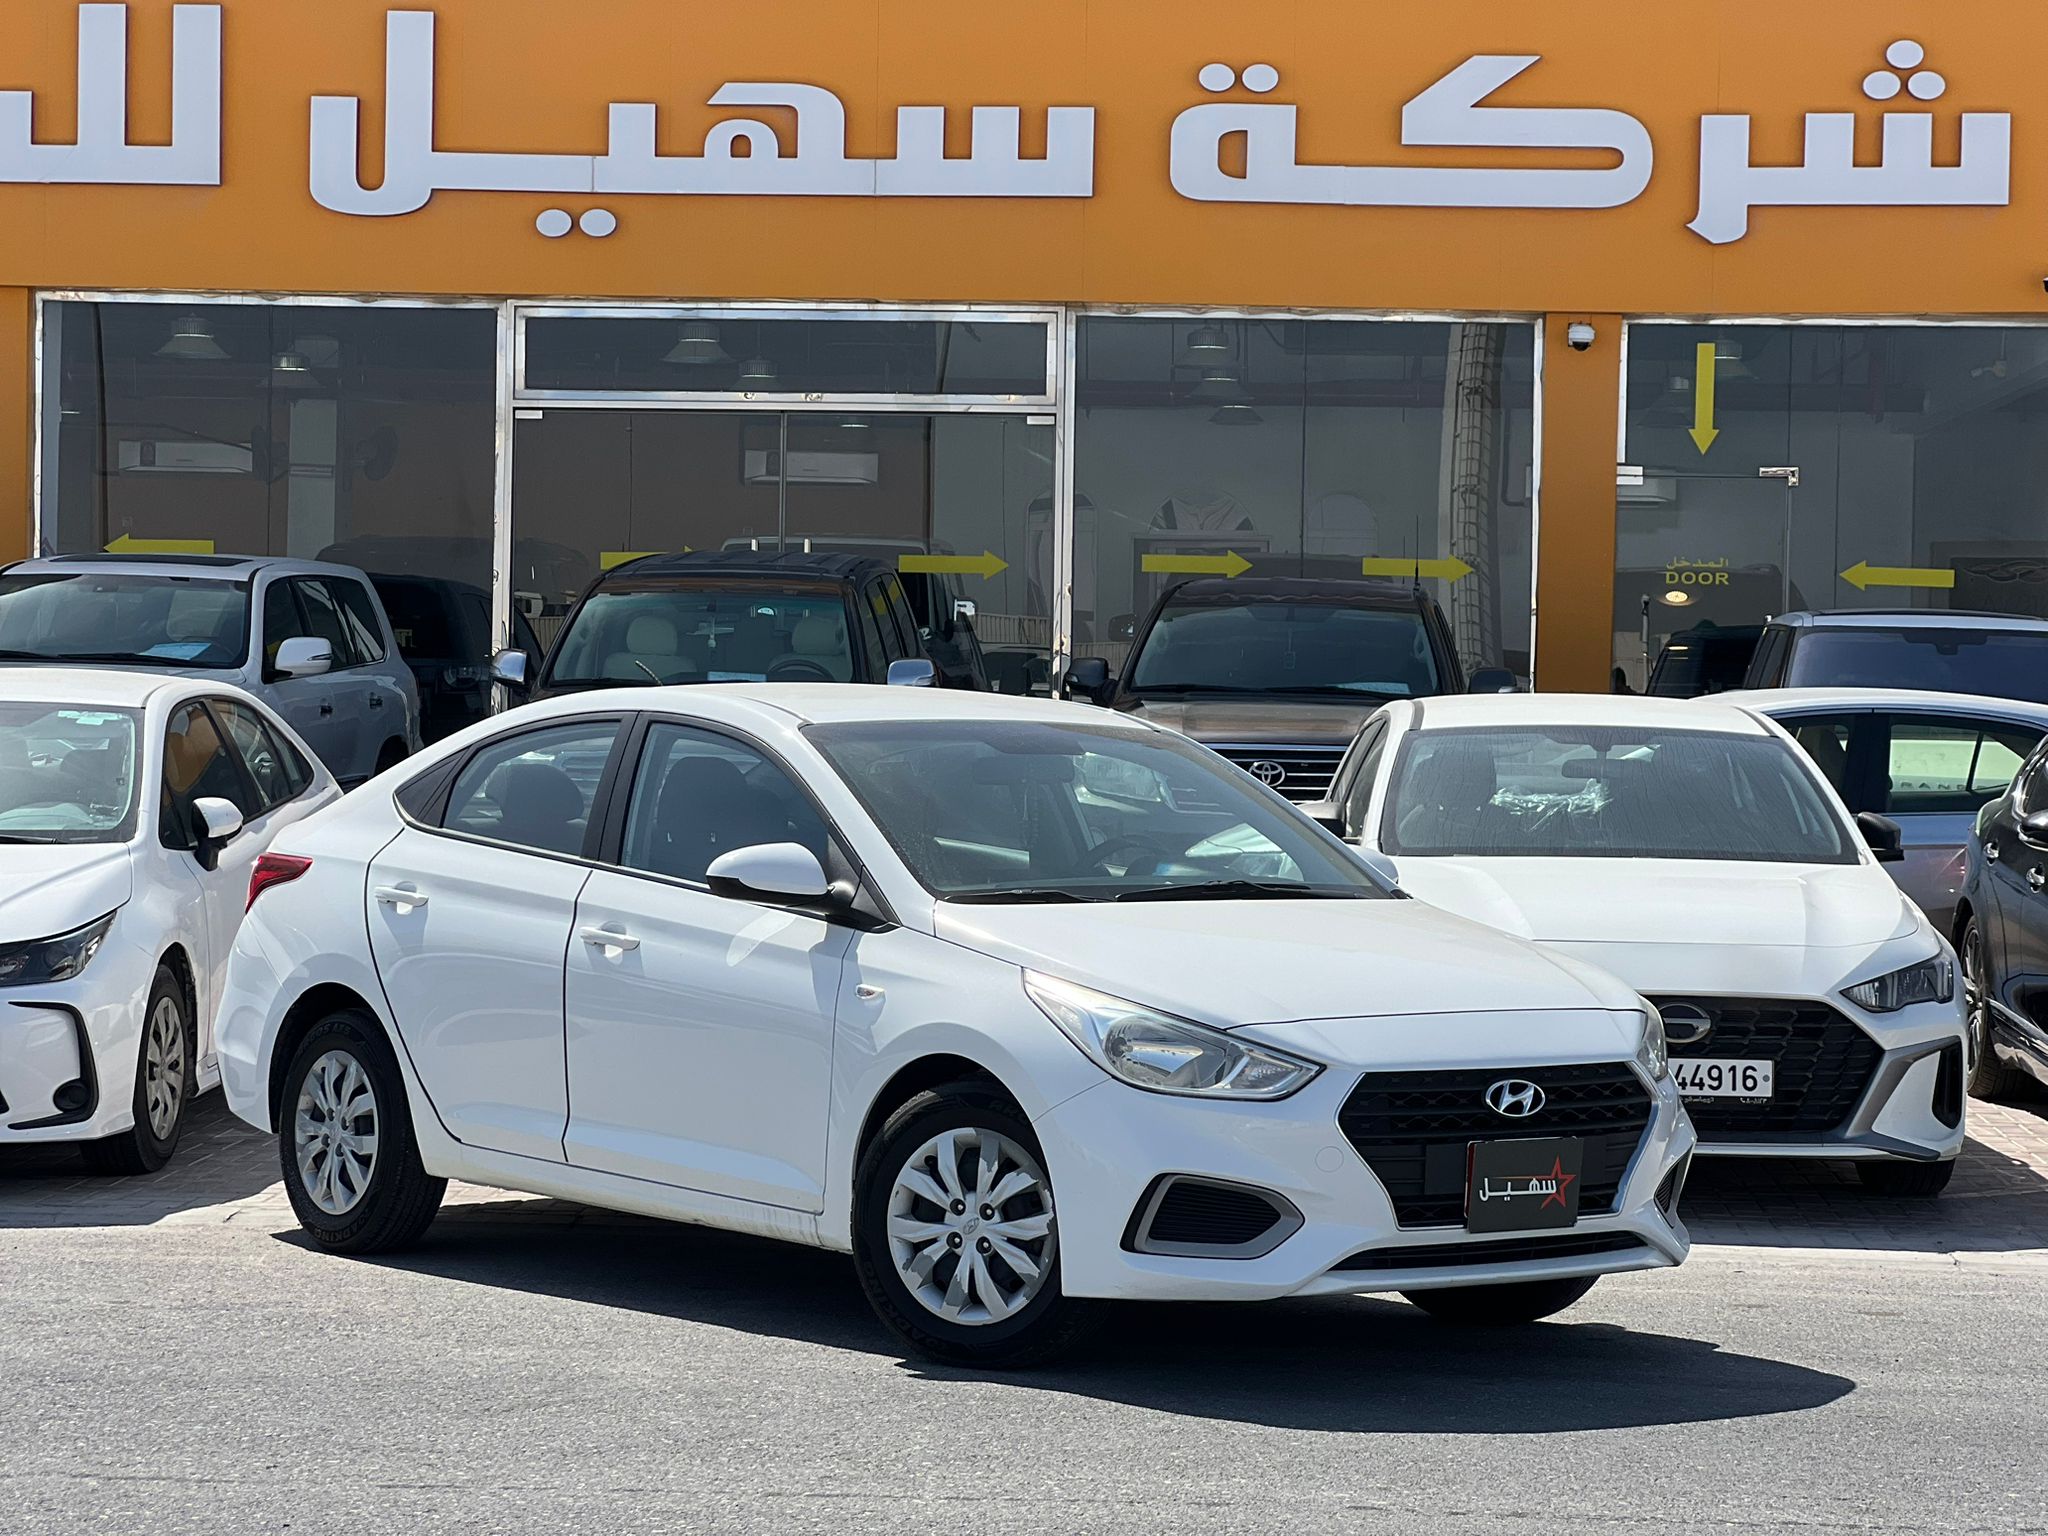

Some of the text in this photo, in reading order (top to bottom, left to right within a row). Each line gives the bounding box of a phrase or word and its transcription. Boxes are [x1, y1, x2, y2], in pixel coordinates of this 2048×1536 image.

[310, 9, 1096, 239] سهيل
[1169, 40, 2012, 245] شركة
[1666, 556, 1729, 569] المدخل
[1665, 571, 1729, 585] DOOR
[1479, 1177, 1557, 1202] سهيل
